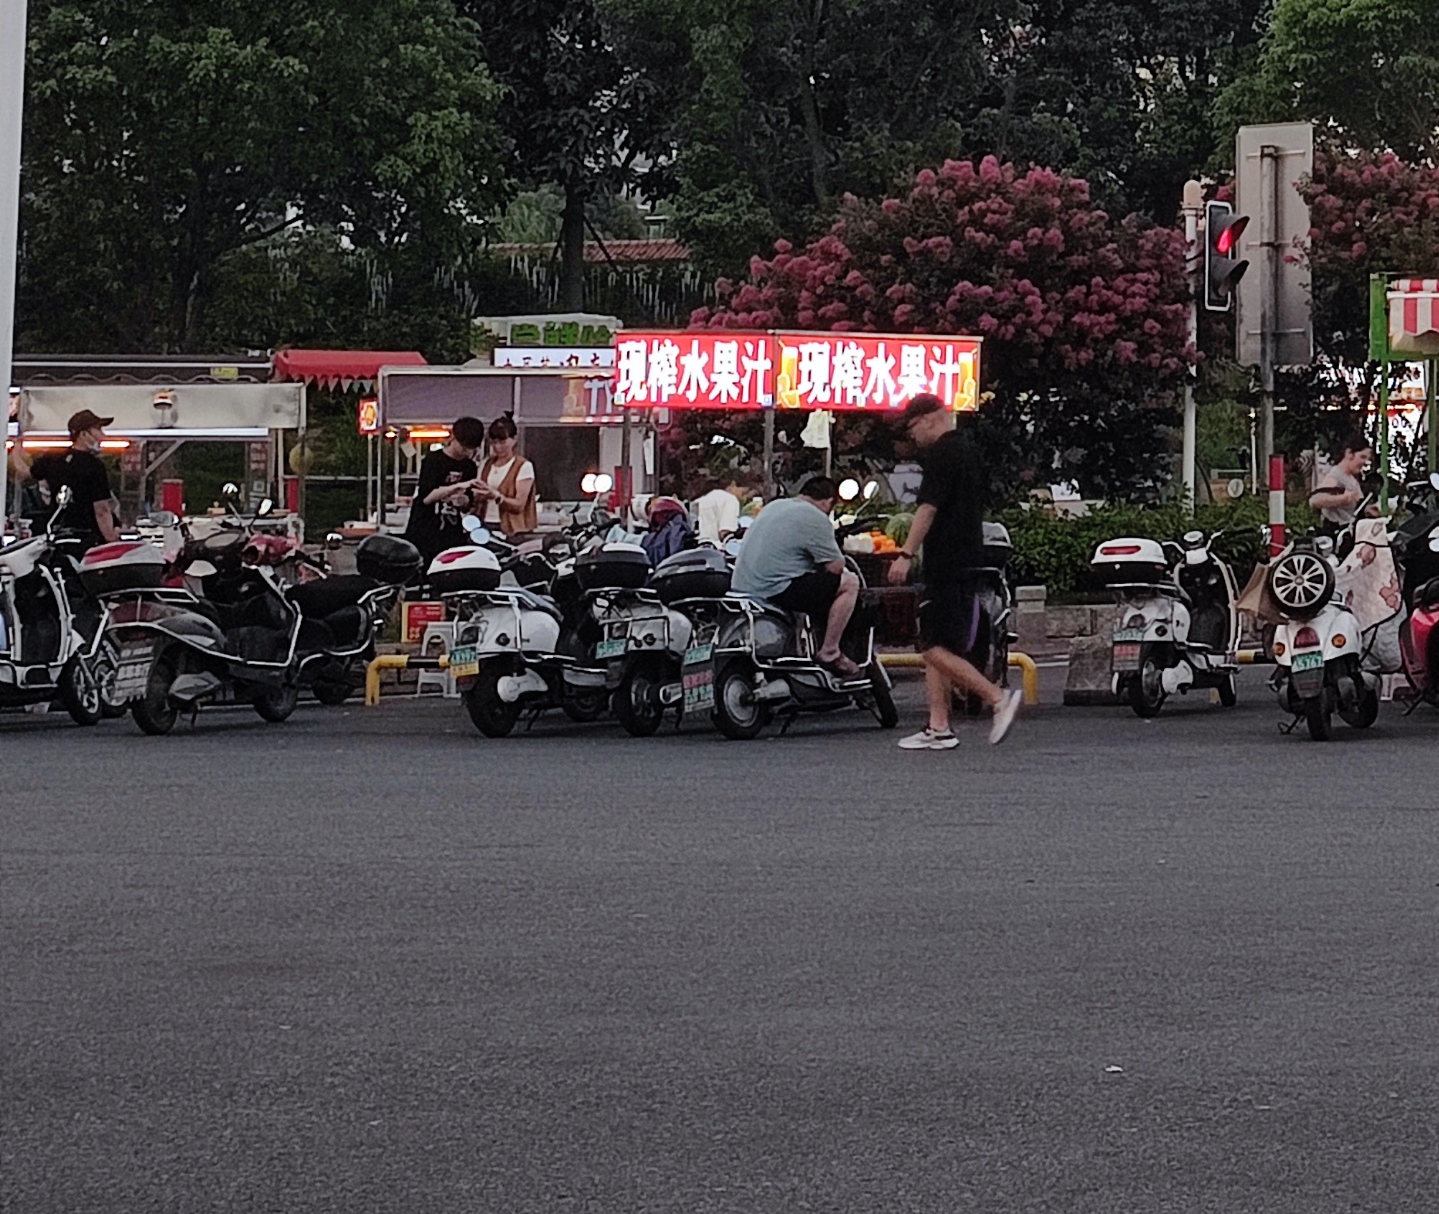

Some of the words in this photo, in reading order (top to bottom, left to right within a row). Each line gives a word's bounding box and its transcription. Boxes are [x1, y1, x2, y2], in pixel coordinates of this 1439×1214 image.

[616, 338, 773, 404] 现榨水果汁
[797, 339, 961, 406] 现榨水果汁
